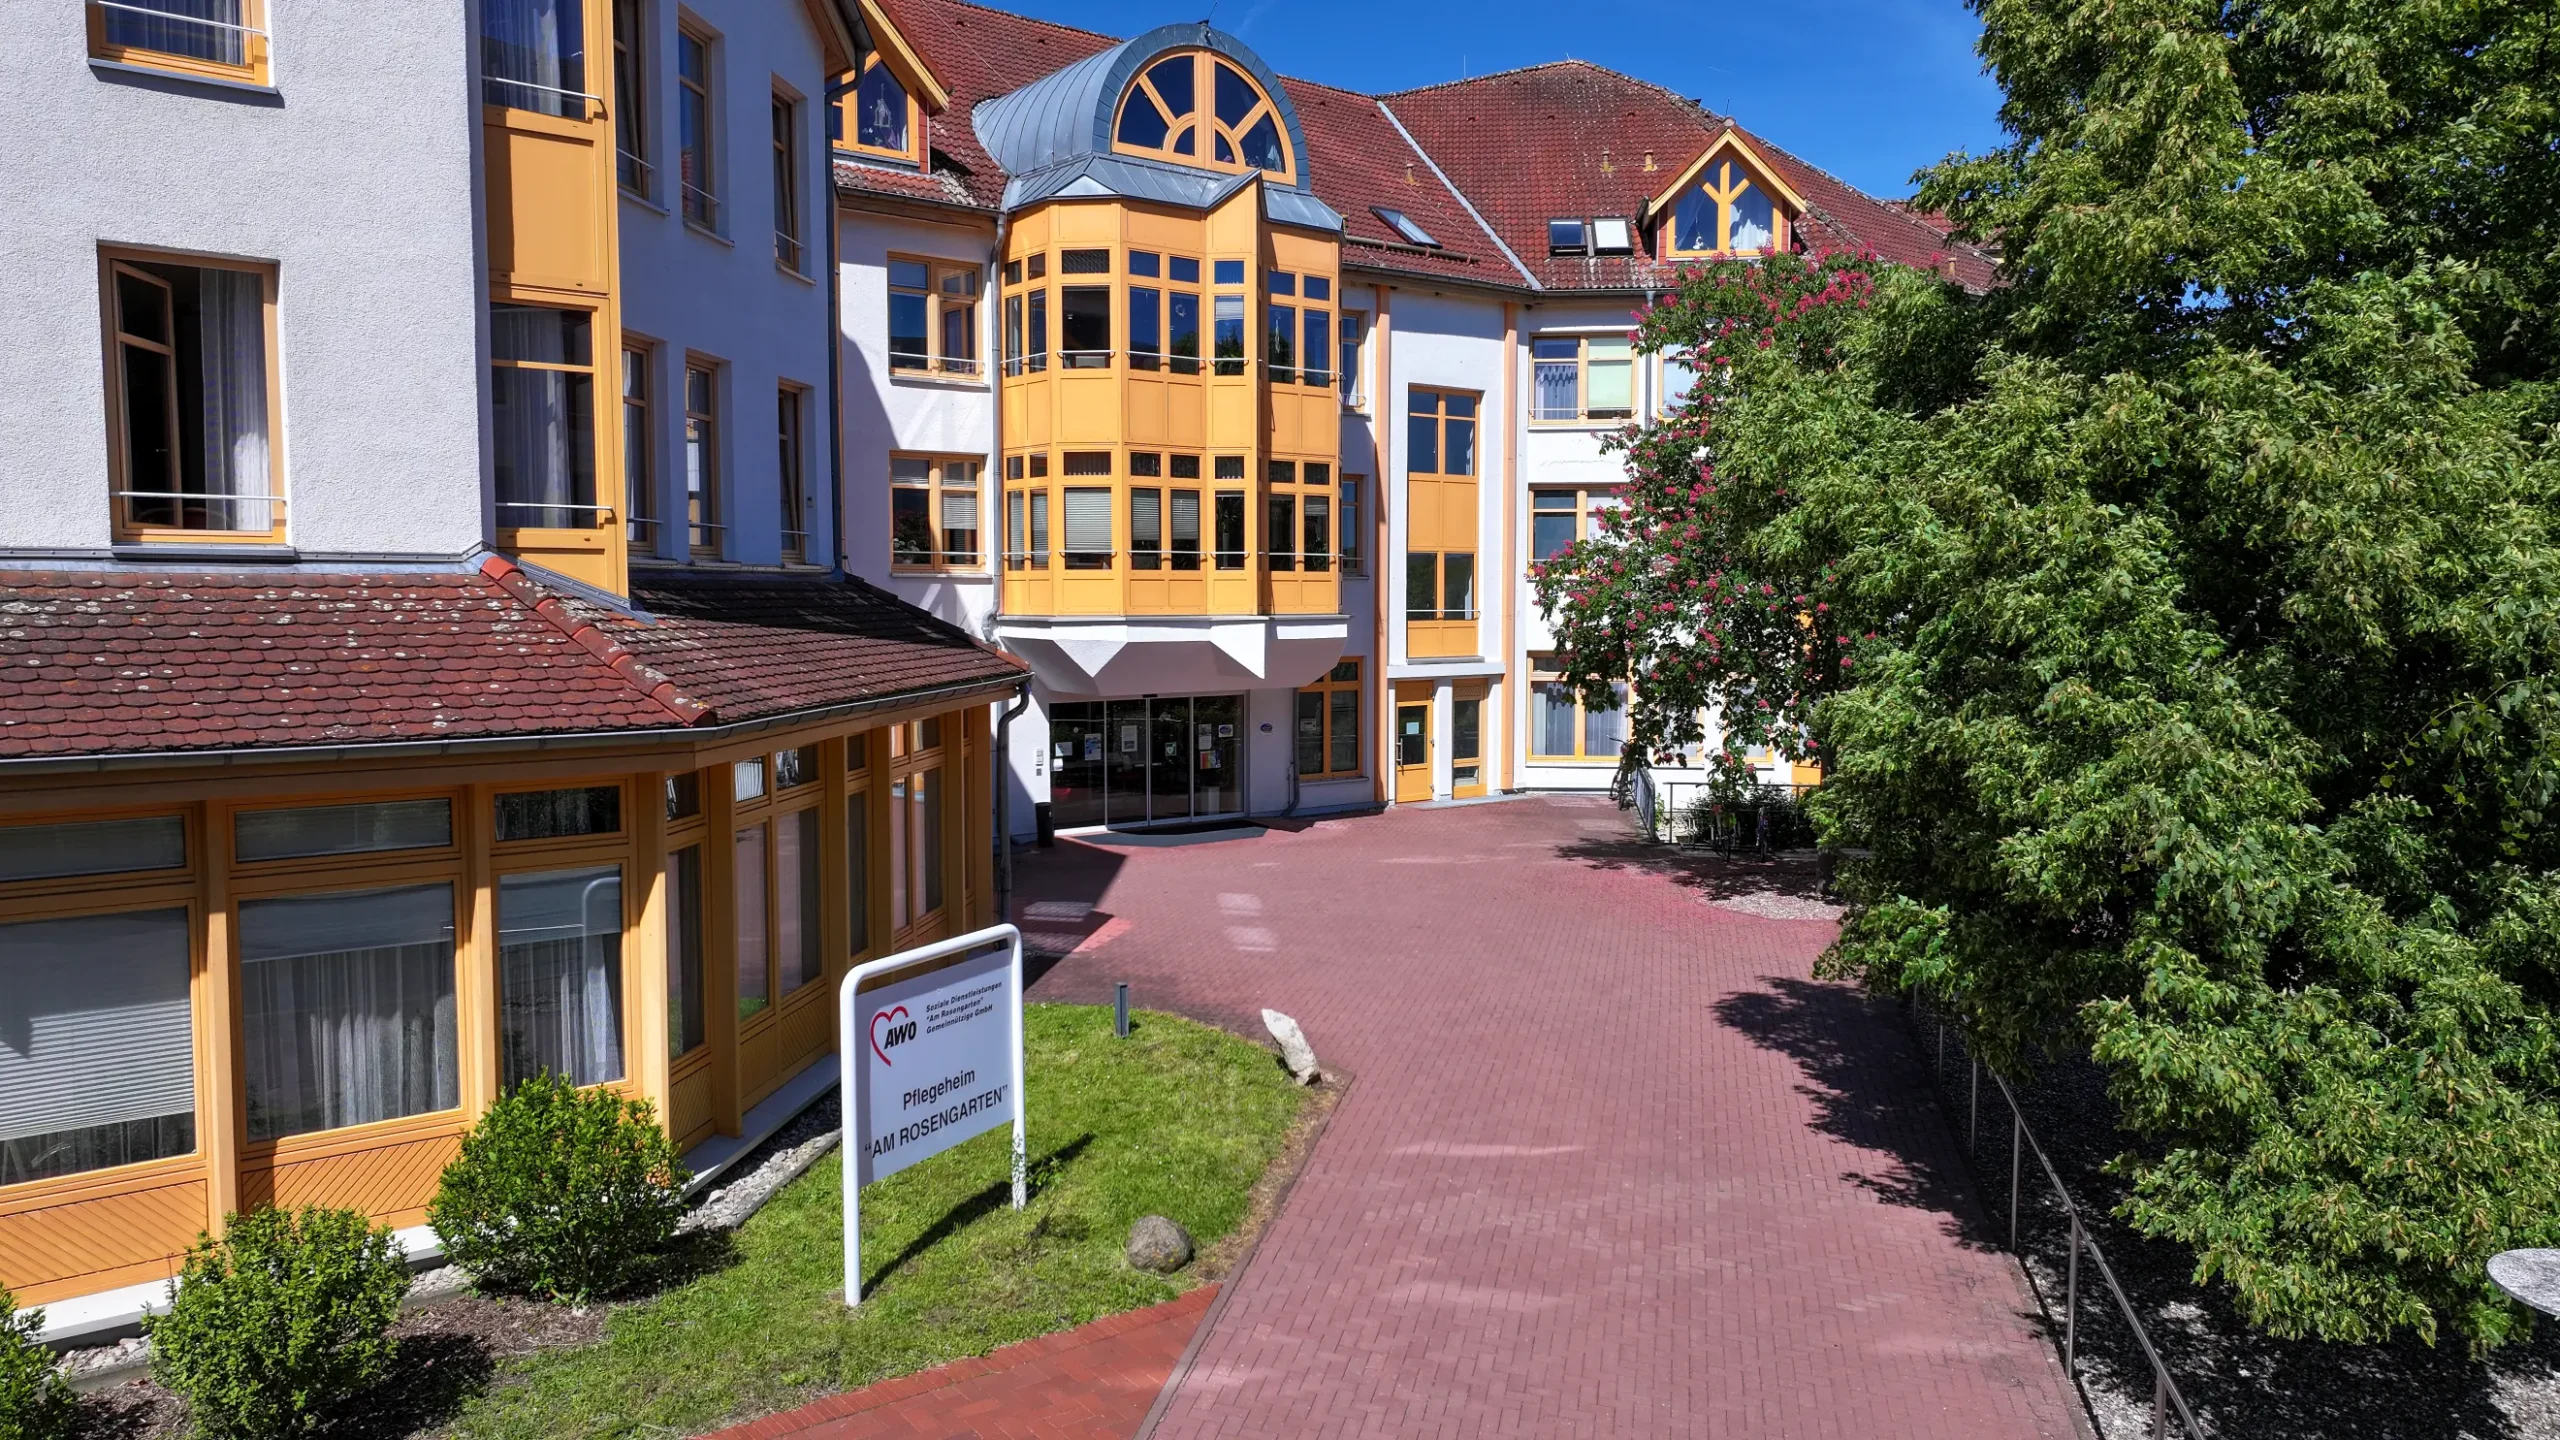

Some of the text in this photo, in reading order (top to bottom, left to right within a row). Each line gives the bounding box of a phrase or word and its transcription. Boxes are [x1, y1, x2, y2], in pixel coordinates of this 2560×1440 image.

[926, 981, 1003, 1013] Soziale Dienstleistungen
[926, 1004, 993, 1034] Gemeinnützige GmbH
[884, 1020, 917, 1050] AWO
[903, 1069, 975, 1111] Pflegeheim
